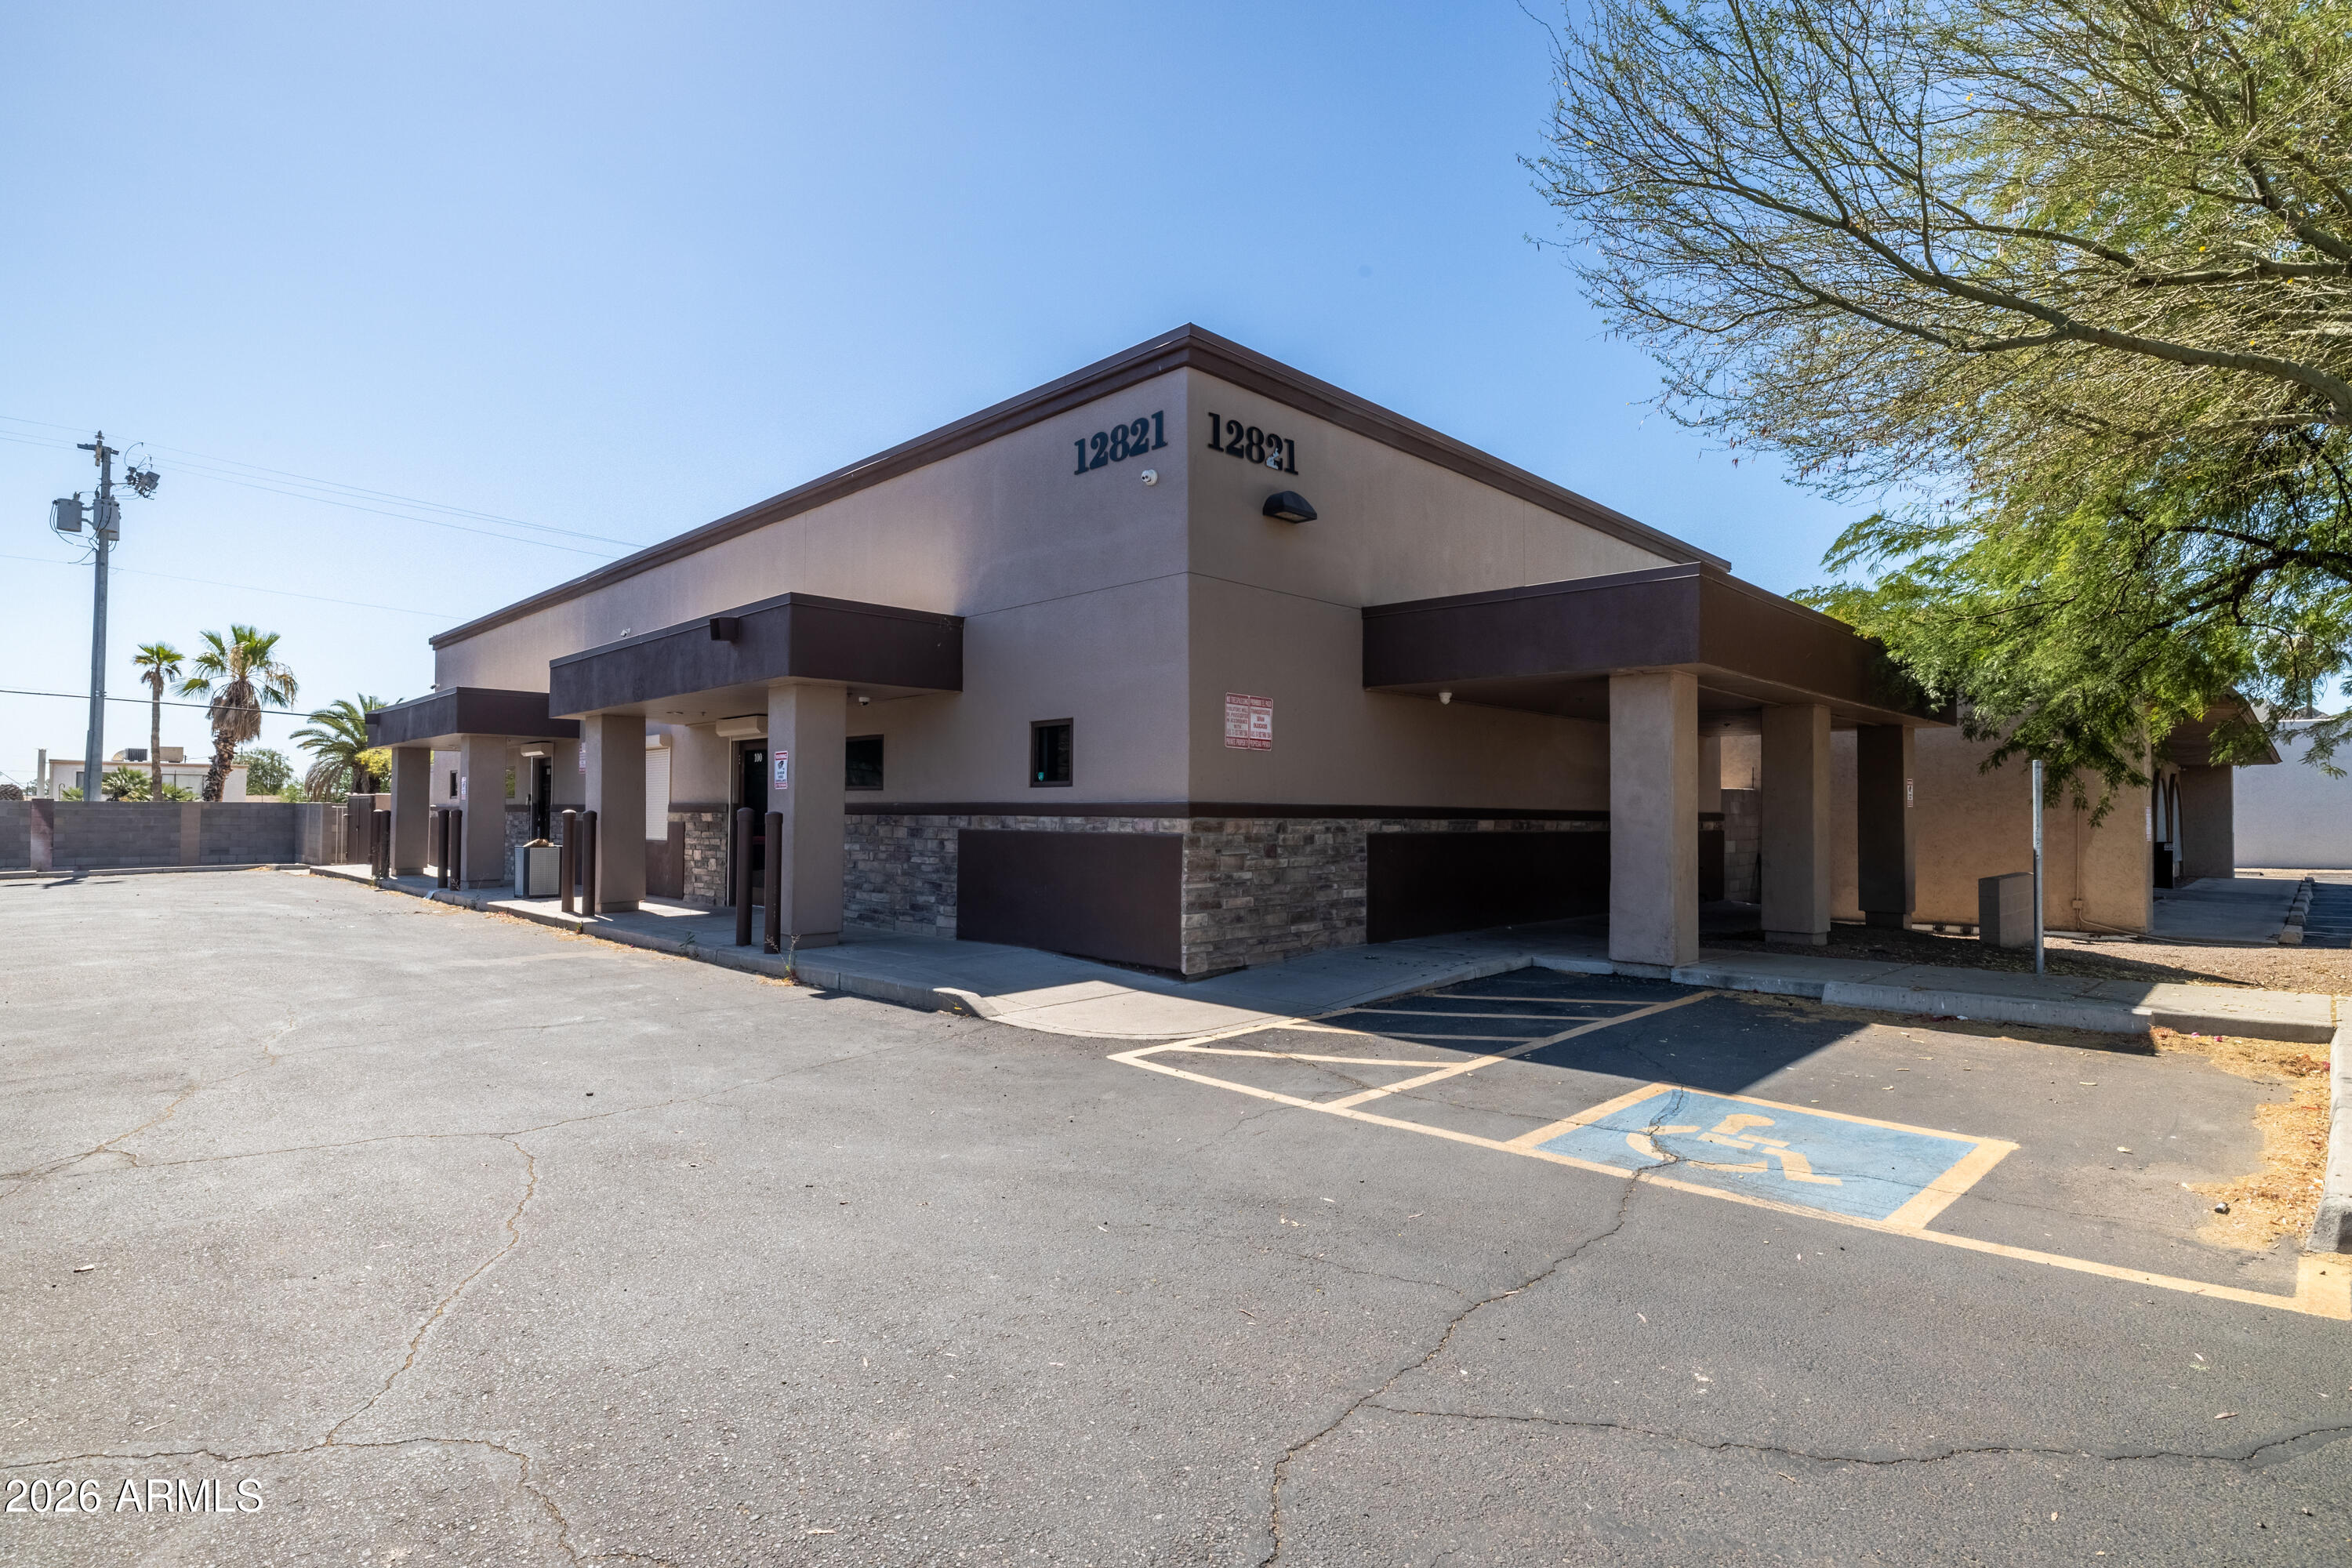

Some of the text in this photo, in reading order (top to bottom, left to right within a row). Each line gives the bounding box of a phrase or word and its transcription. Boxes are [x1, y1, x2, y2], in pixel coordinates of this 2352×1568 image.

[1074, 410, 1168, 475] 12821
[1207, 412, 1299, 475] 12821
[753, 753, 763, 762] 100
